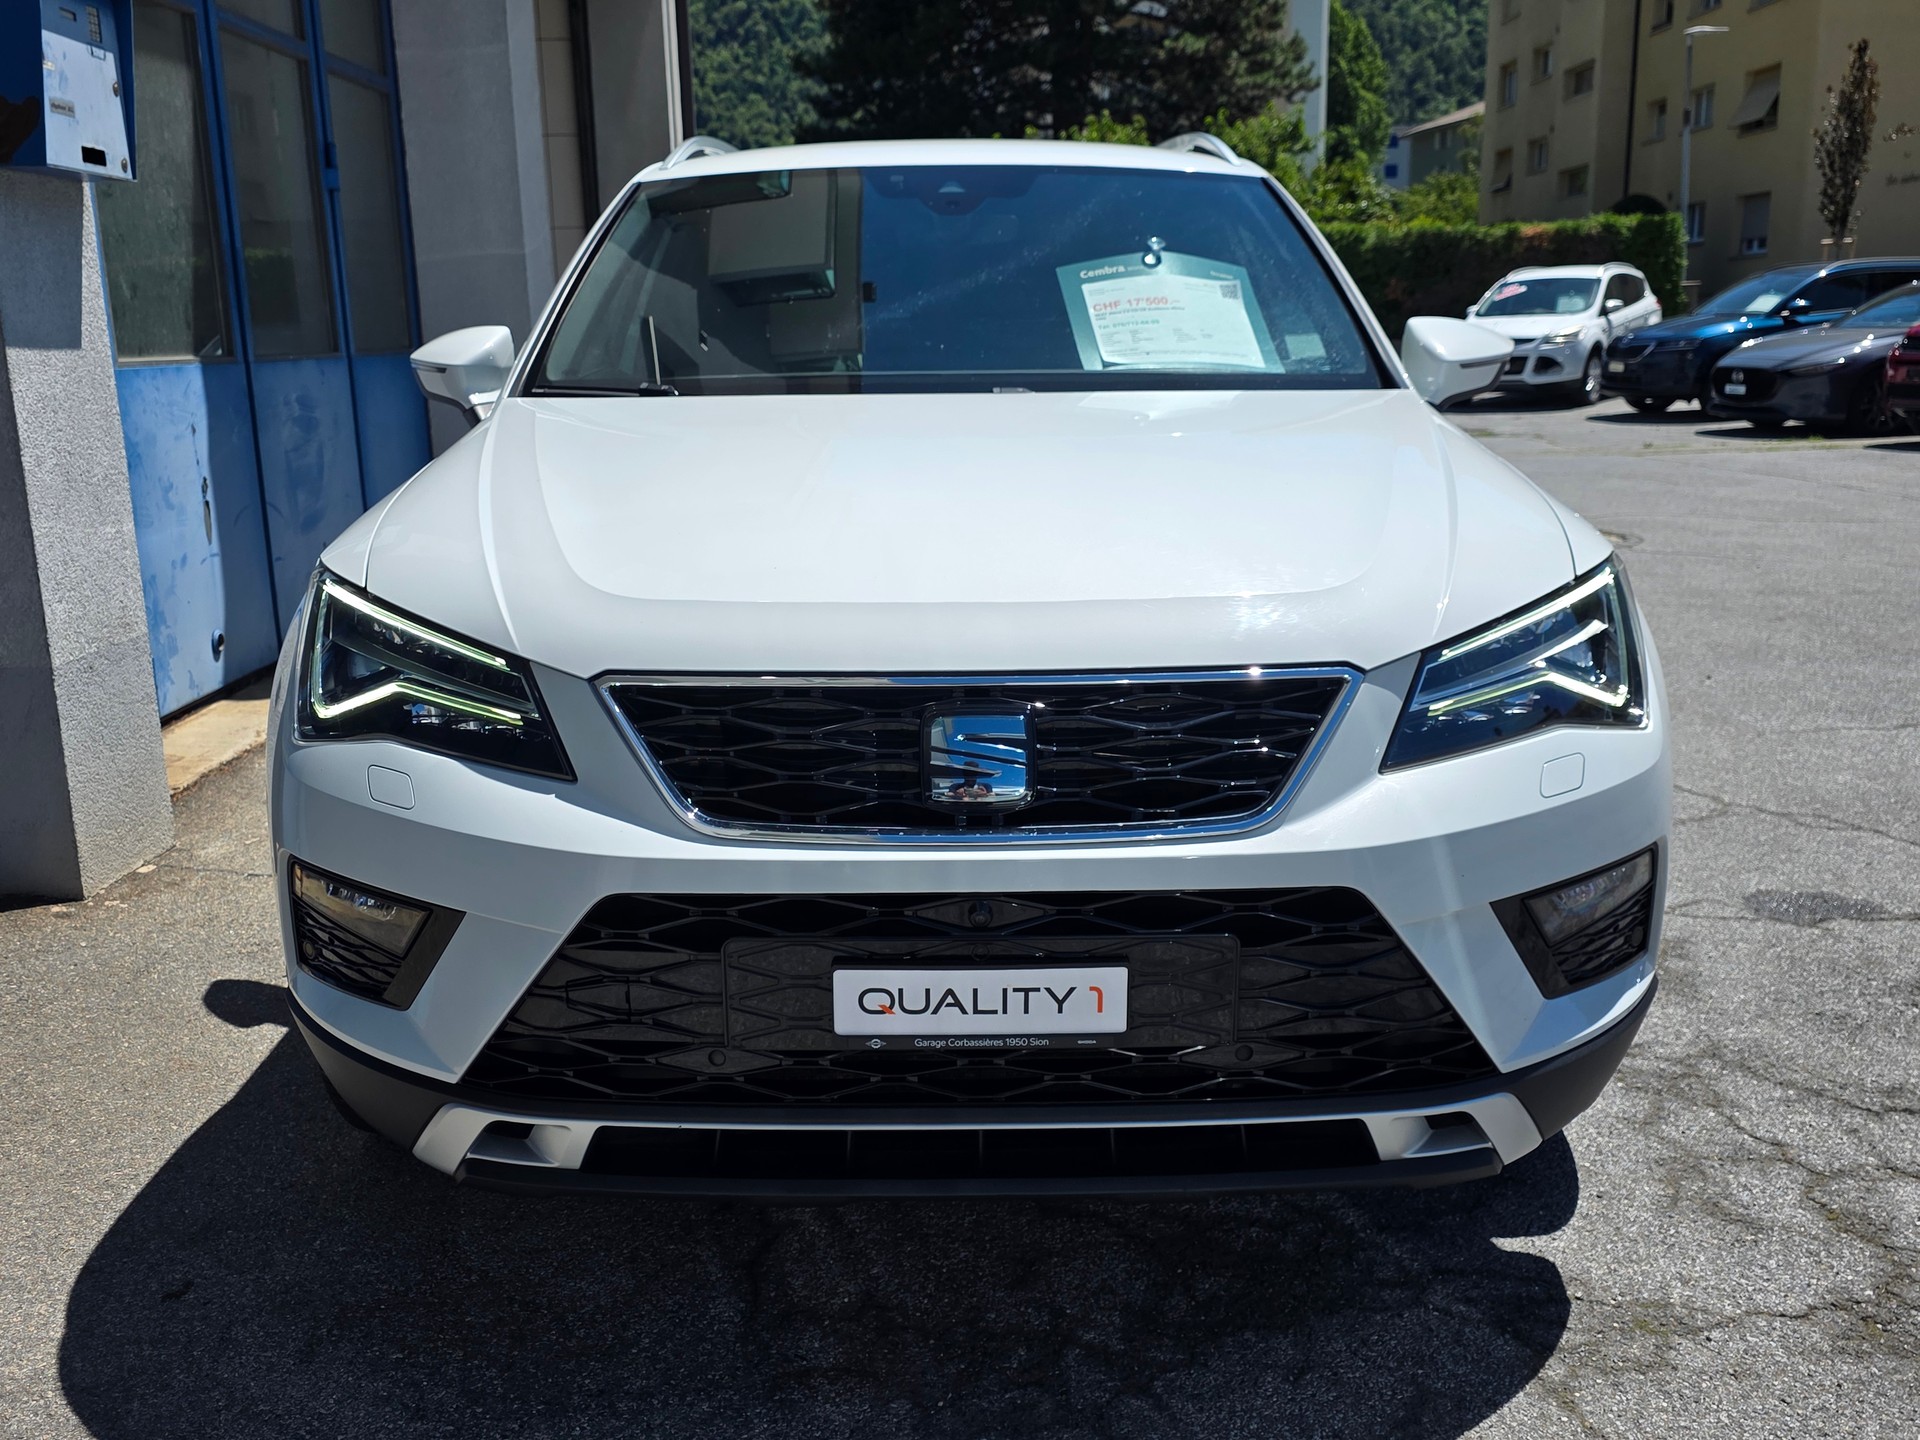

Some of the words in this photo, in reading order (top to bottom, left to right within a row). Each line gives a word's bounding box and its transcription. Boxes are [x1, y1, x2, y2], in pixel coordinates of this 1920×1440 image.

[1080, 265, 1126, 279] Cembra
[1093, 300, 1120, 312] CHF
[858, 986, 1077, 1015] QUALITY
[1089, 986, 1103, 1013] 1
[914, 1038, 946, 1048] Garage
[948, 1038, 1003, 1047] Corbassières
[1006, 1037, 1028, 1047] 1950
[1030, 1037, 1049, 1047] Sion
